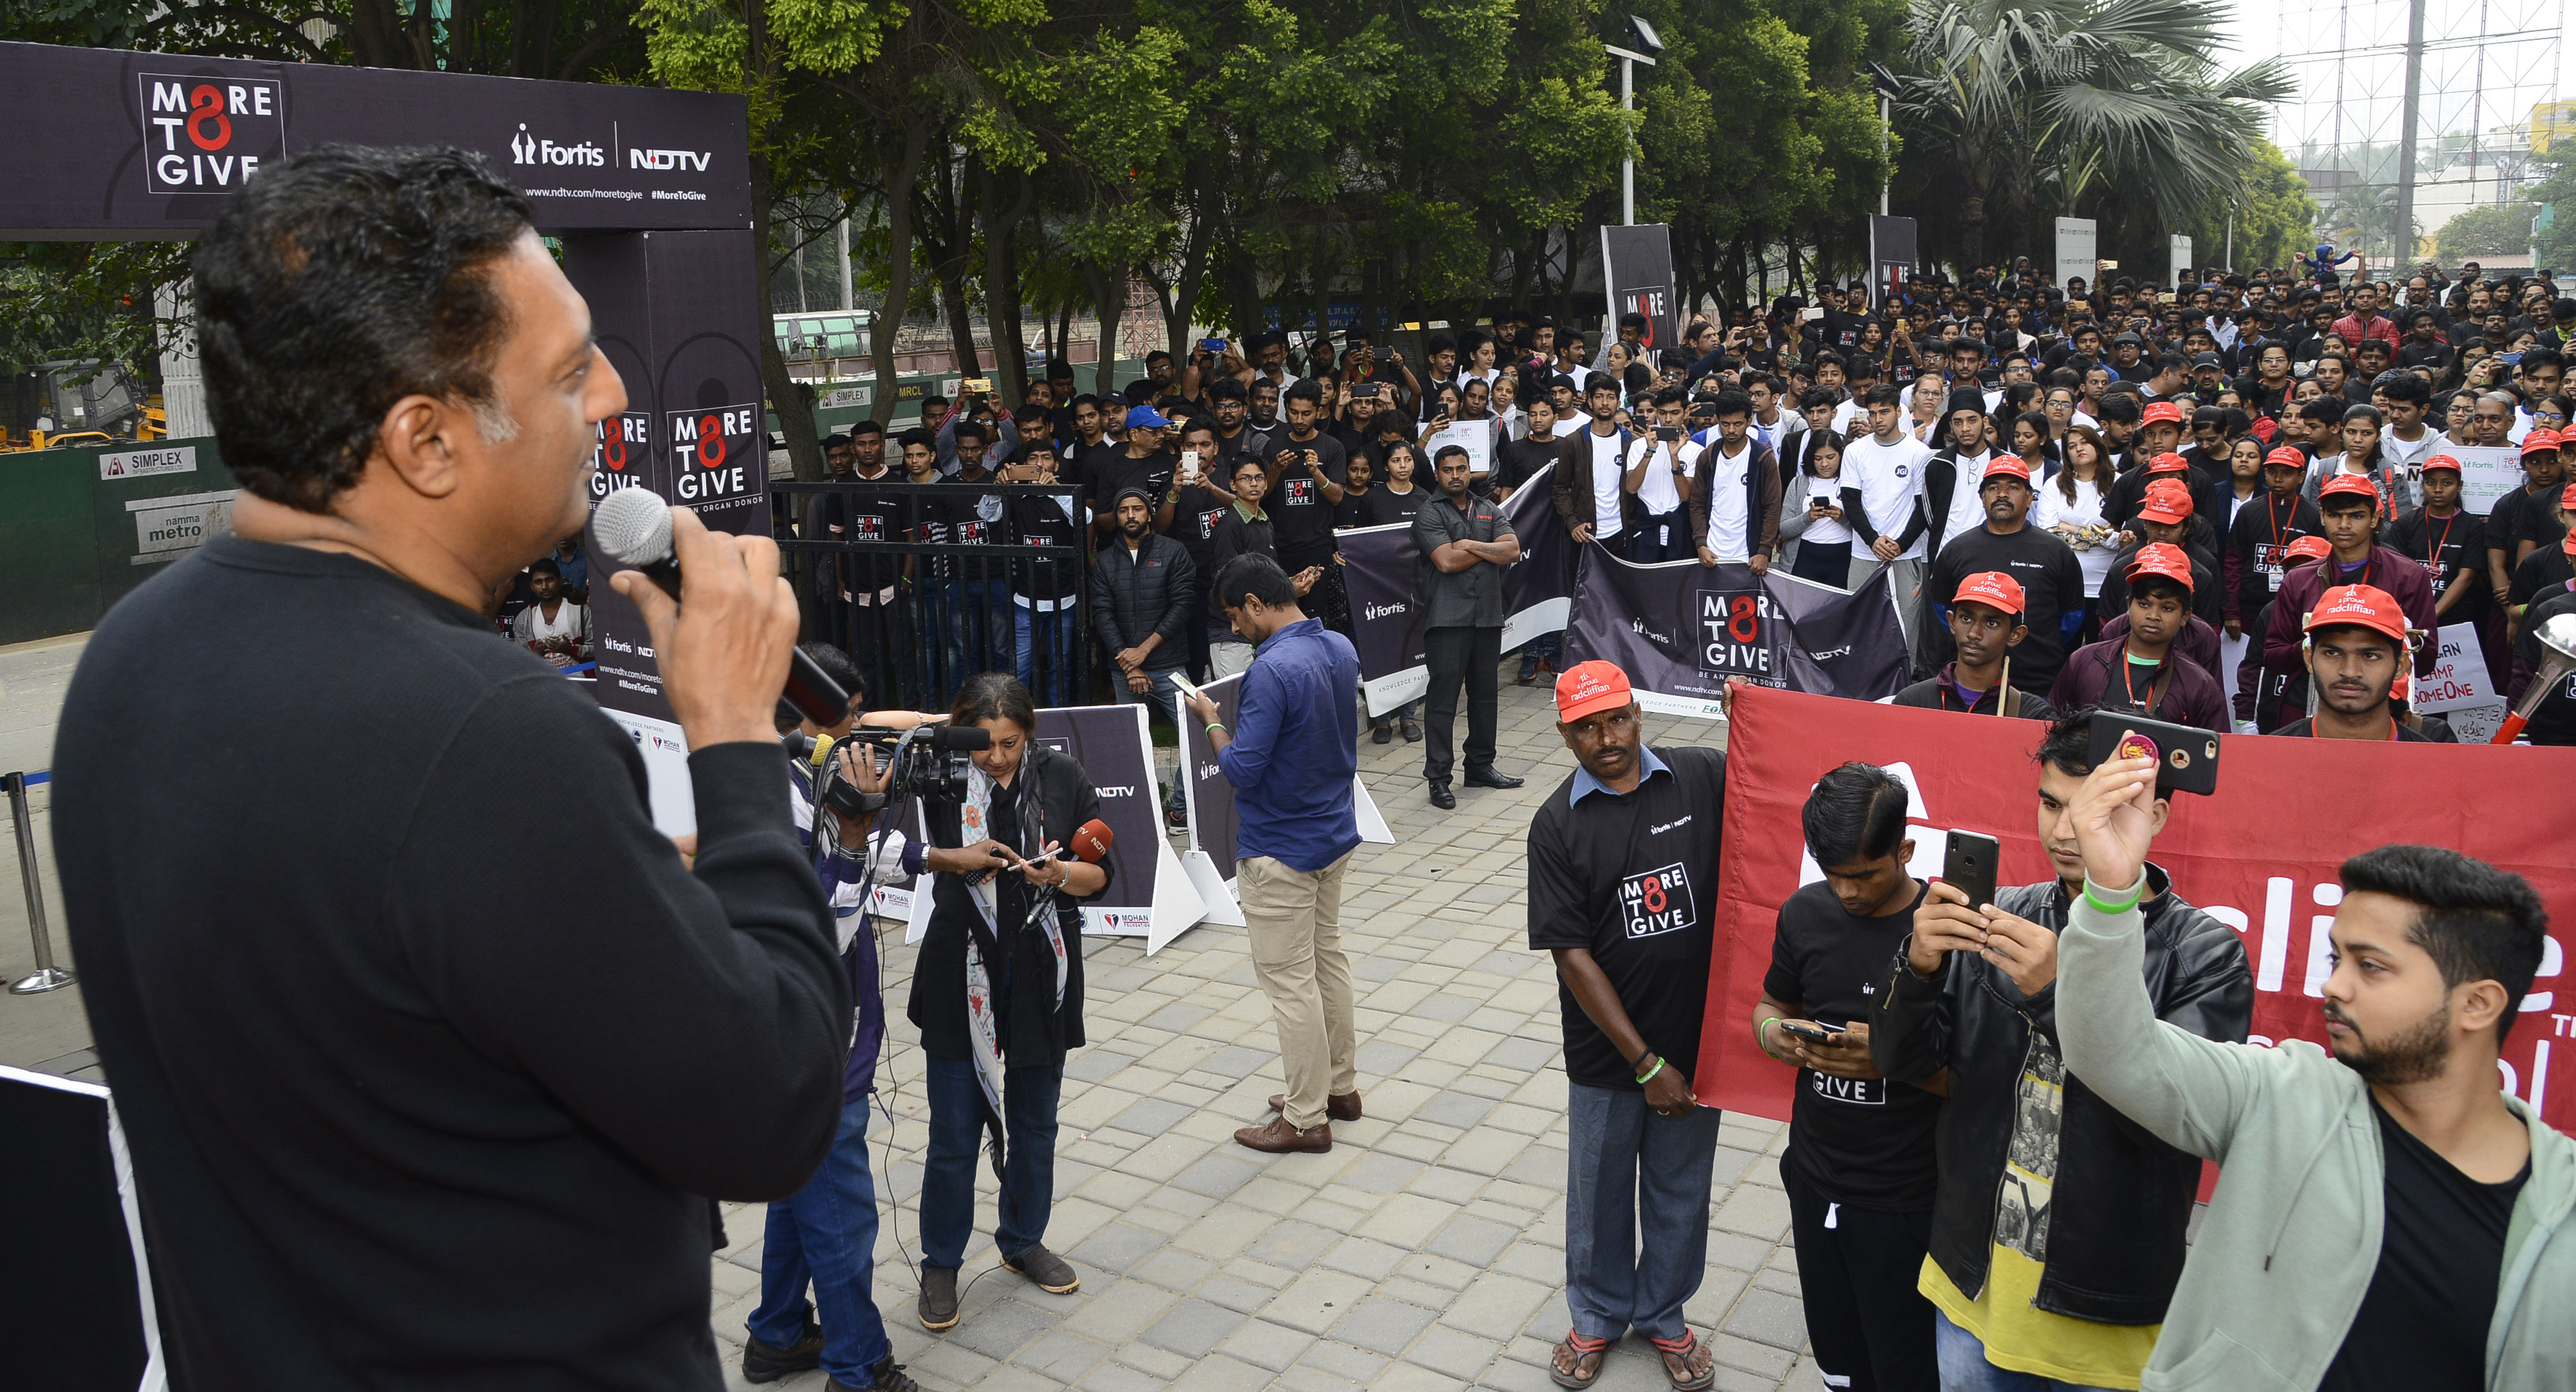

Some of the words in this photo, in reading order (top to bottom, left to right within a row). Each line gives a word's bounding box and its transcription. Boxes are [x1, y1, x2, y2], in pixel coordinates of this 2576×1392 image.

[541, 139, 604, 166] Fortis
[630, 148, 712, 171] NDTV
[525, 187, 643, 201] www.ndtv.com/moretogive
[652, 190, 707, 200] #MoreToGive
[836, 390, 864, 402] SIMPLEX
[899, 385, 923, 397] MRCL
[131, 451, 182, 468] SIMPLEX
[678, 467, 745, 499] GIVE
[703, 501, 731, 512] ORGAN
[735, 496, 763, 507] DONOR
[165, 515, 200, 526] namma
[149, 525, 201, 542] metro
[1969, 585, 2007, 600] radcliffian
[1377, 602, 1406, 618] Fortis
[2326, 604, 2376, 616] radcliffian
[612, 639, 632, 653] Fortis
[637, 646, 657, 658] NDT
[1810, 645, 1851, 660] NDTV
[1706, 643, 1769, 671] GIVE
[599, 665, 663, 684] www.ndtv.com/moreto
[618, 679, 658, 695] #MoreToGive
[1379, 678, 1411, 692] KNOWLEDGE
[1580, 679, 1599, 689] proud
[1760, 679, 1787, 689] DONOR
[1570, 684, 1610, 702] radcliffian
[663, 739, 680, 748] MOHAN
[1095, 786, 1135, 798] NDTV
[1673, 815, 1691, 827] NDTV
[887, 893, 908, 903] MOHAN
[1630, 909, 1684, 935] GIVE
[1814, 1072, 1866, 1100] GIVE
